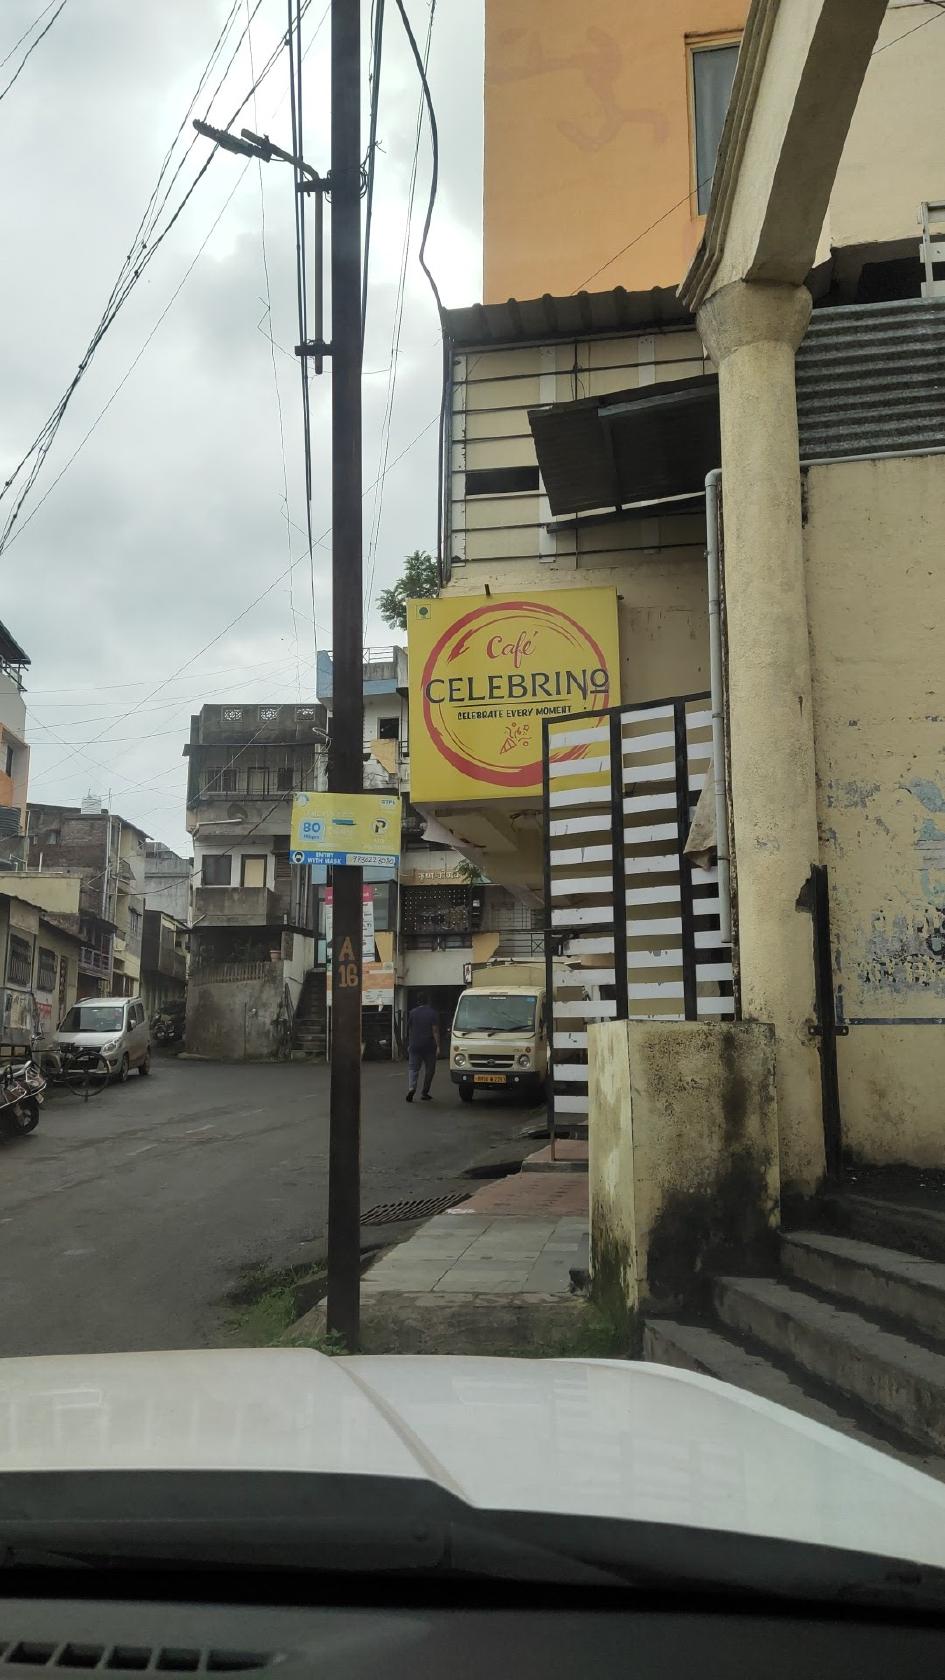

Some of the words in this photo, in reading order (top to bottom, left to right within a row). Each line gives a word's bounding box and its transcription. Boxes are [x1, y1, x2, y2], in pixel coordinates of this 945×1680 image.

[486, 631, 538, 669] Café
[425, 668, 609, 704] CELEBRINO
[457, 709, 503, 720] CELEBRATE
[506, 707, 534, 718] EVERY
[535, 705, 572, 716] MOMENT
[303, 822, 321, 833] 80
[338, 936, 356, 961] A
[338, 963, 359, 988] 16
